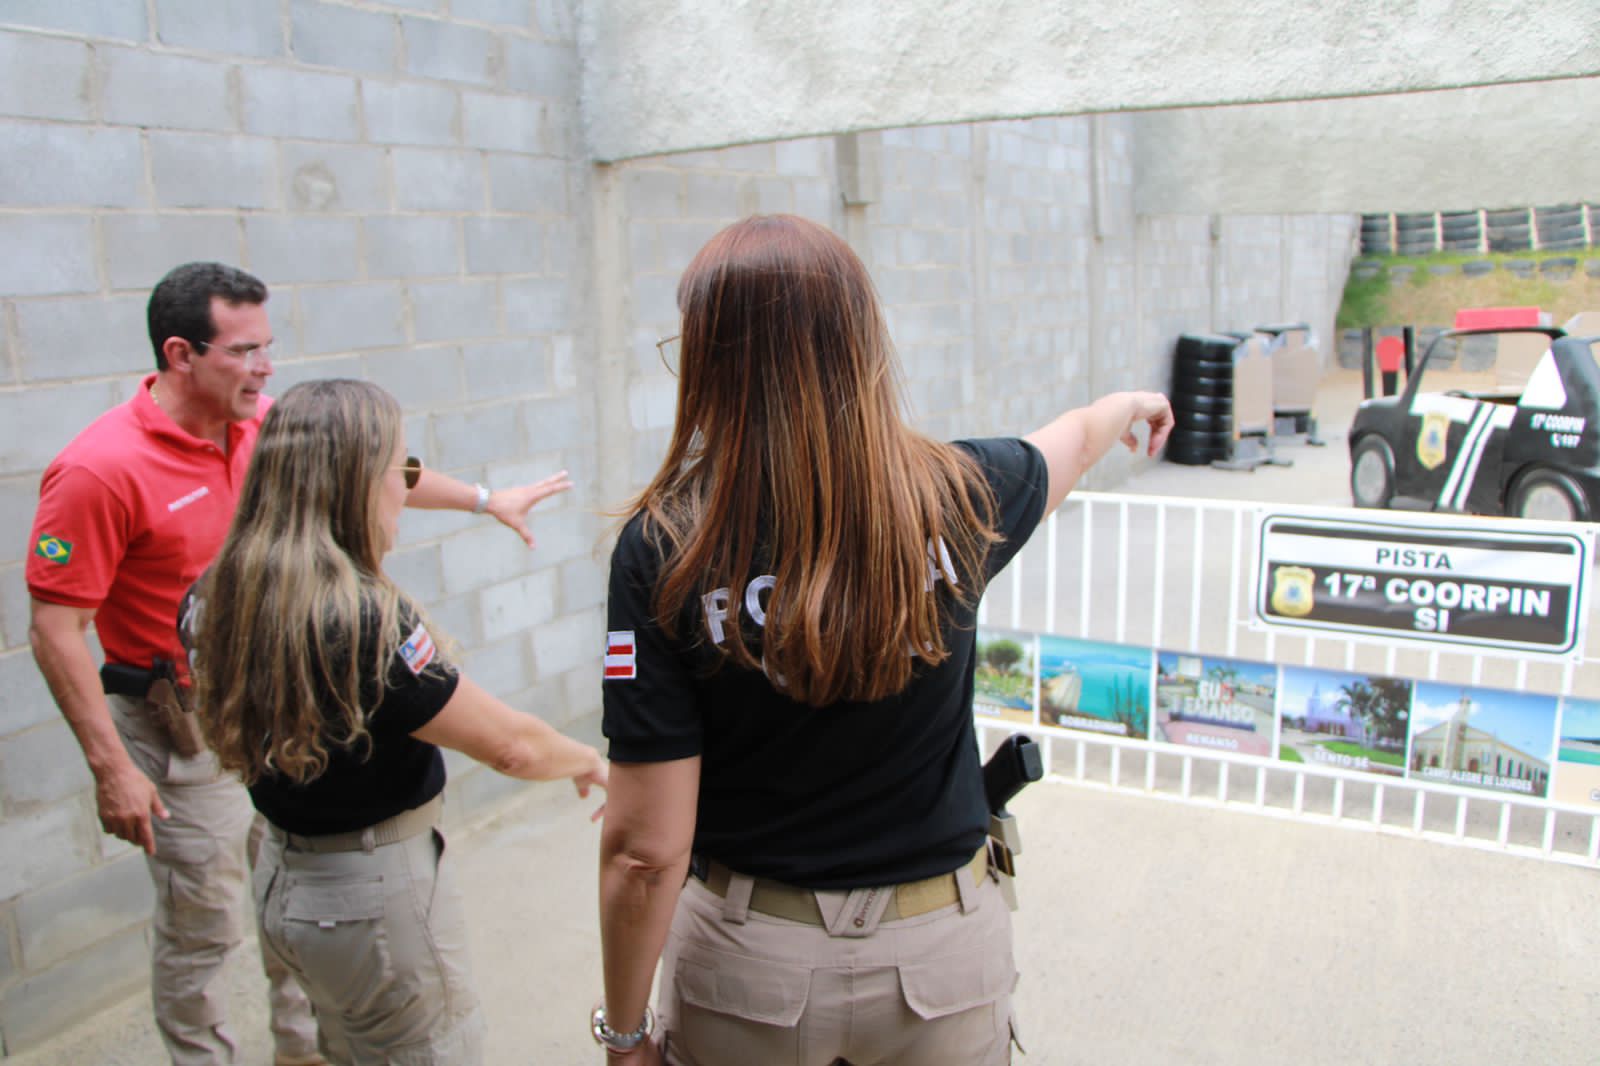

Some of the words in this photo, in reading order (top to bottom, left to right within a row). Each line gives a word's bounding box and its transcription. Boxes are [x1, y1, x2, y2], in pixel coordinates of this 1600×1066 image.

[1376, 547, 1452, 570] PISTA
[1384, 577, 1551, 617] COORPIN
[1413, 606, 1450, 633] SI
